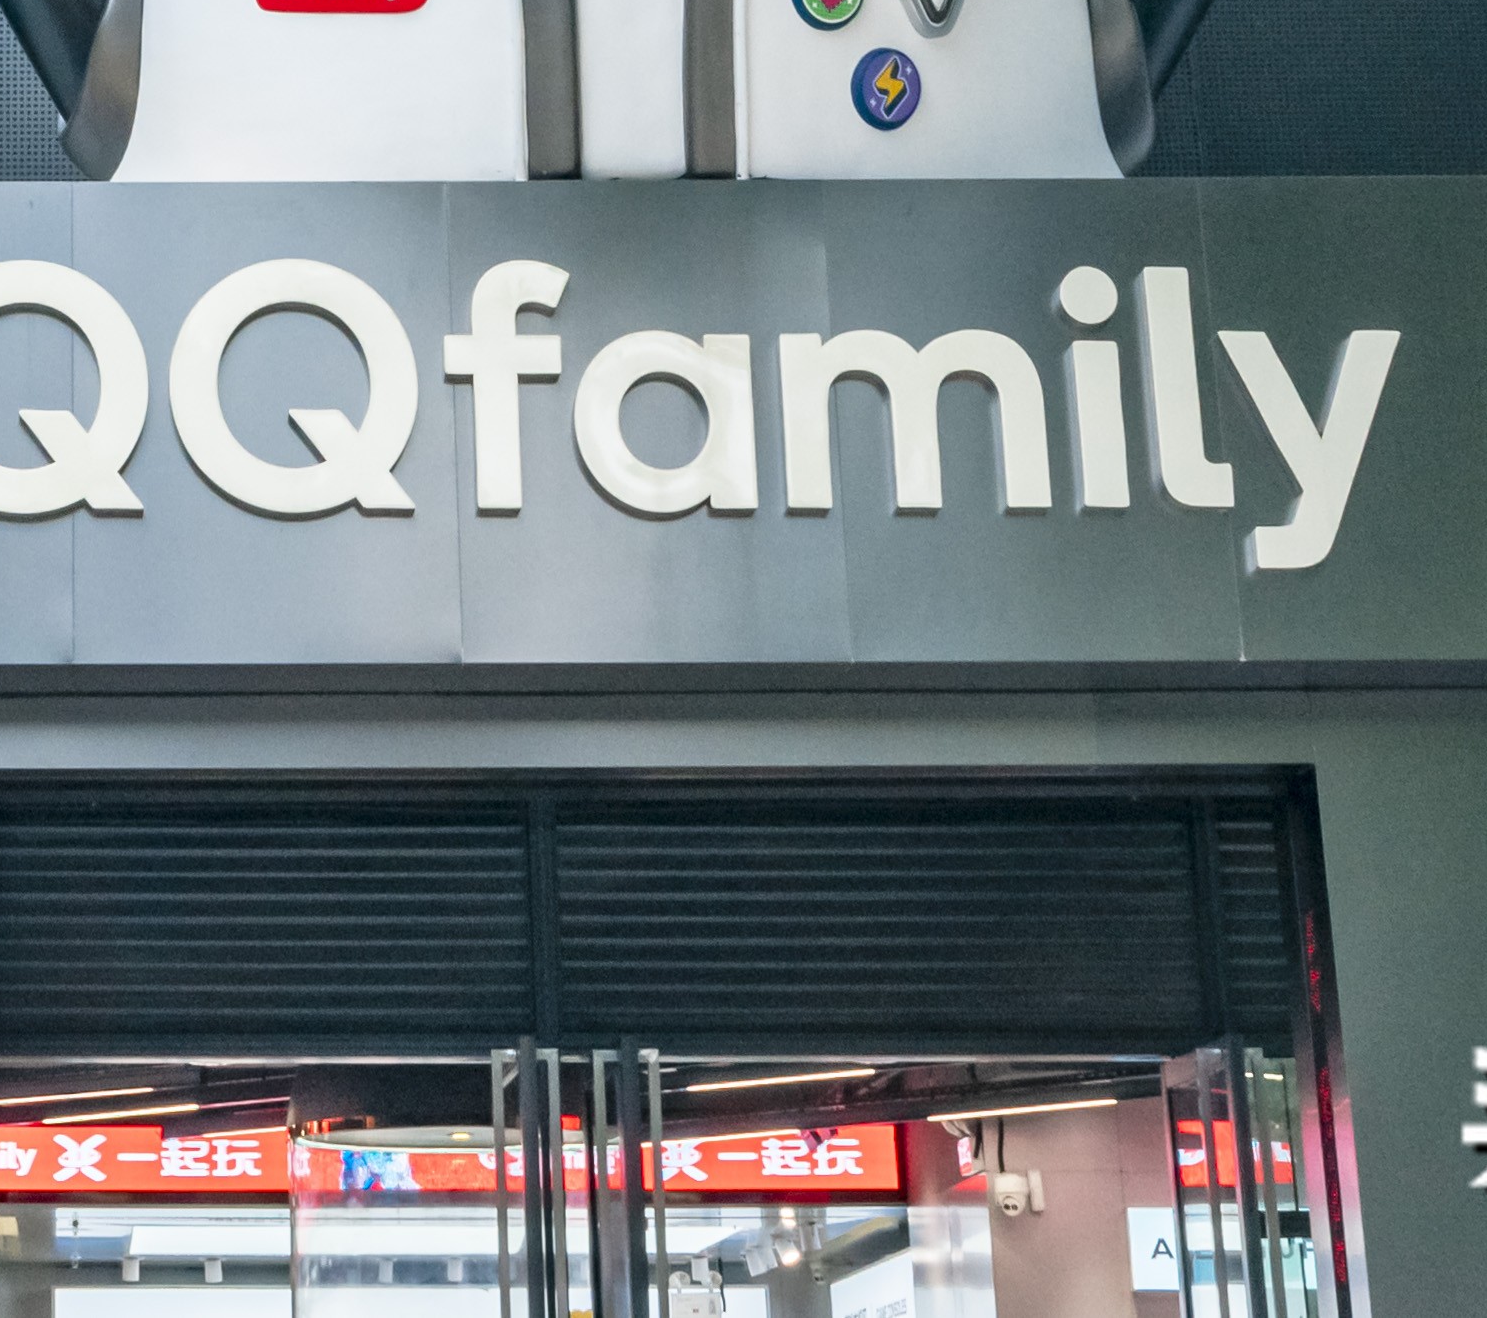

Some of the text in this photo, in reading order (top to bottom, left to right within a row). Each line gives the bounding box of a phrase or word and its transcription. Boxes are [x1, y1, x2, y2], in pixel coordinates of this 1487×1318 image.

[116, 1138, 263, 1177] 一起玩
[717, 1138, 864, 1176] 一起玩
